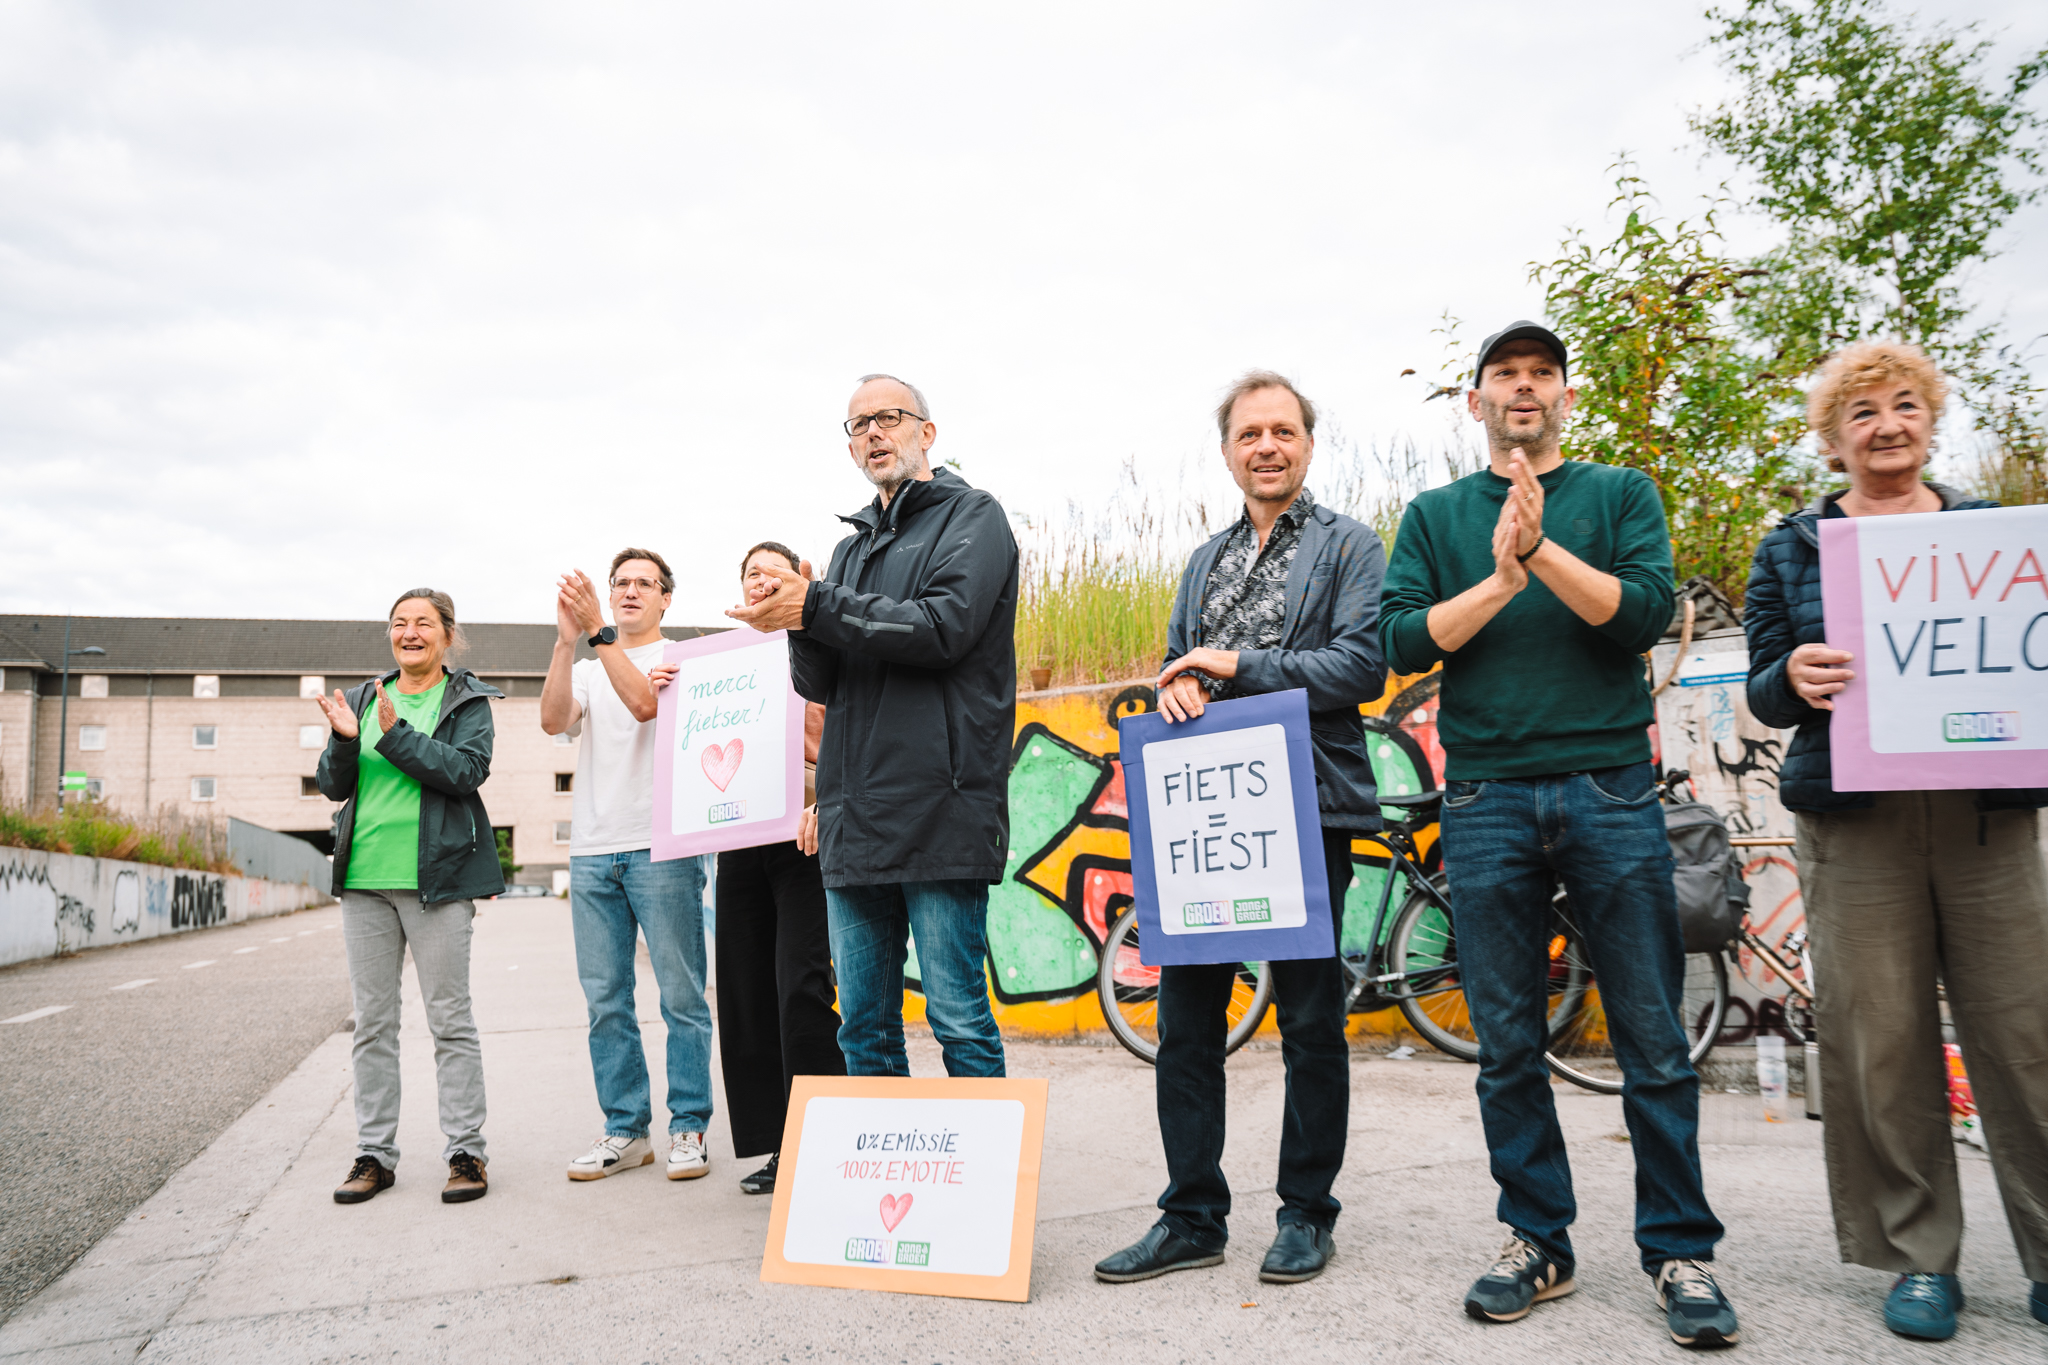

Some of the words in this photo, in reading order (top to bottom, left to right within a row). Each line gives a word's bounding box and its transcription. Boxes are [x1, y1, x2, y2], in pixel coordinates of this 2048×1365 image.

[688, 669, 757, 700] merci
[709, 800, 746, 823] GROEN
[1184, 901, 1230, 925] GROEN
[1235, 900, 1261, 912] JONG
[1236, 910, 1269, 922] GROEN
[846, 1238, 892, 1262] GROEN
[897, 1252, 926, 1265] GROEN
